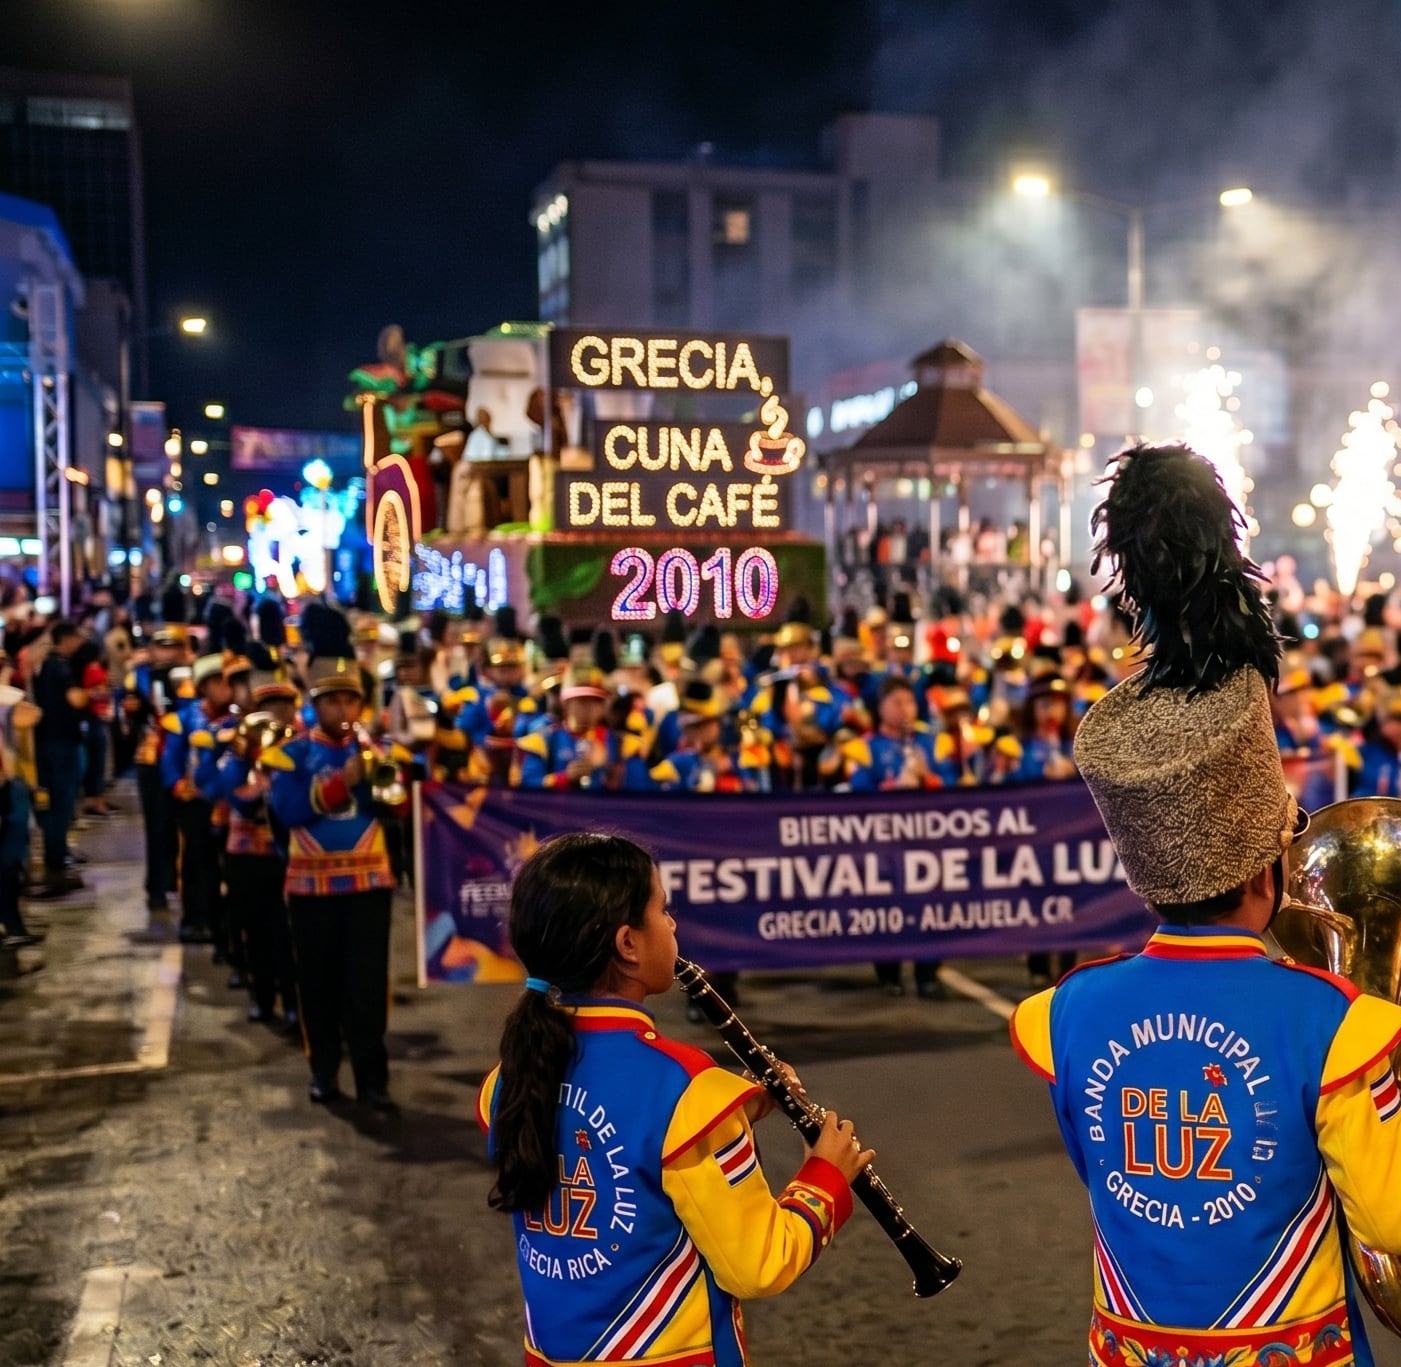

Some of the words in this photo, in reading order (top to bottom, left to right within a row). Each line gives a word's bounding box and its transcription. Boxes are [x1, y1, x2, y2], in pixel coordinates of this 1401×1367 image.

[570, 334, 774, 397] GRECIA,
[604, 423, 734, 472] CUNA
[569, 480, 657, 528] DEL
[665, 473, 781, 528] CAFÉ
[610, 546, 779, 620] 2010
[778, 808, 992, 847] BIENVENIDOS
[996, 806, 1037, 836] AL
[657, 850, 894, 905] FESTIVAL
[903, 848, 970, 895] DE
[981, 844, 1044, 890] LA
[758, 909, 843, 941] GRECIA
[847, 906, 905, 937] 2010
[919, 898, 1040, 933] ALAJUELA,
[1042, 895, 1075, 925] CR
[1083, 1038, 1131, 1142] BANDA
[1130, 1012, 1272, 1096] MUNICIPAL
[588, 1104, 617, 1145] DE
[1120, 1086, 1169, 1120] DE
[1179, 1088, 1229, 1124] LA
[557, 1153, 595, 1187] LA
[605, 1145, 630, 1180] LA
[1123, 1120, 1234, 1181] LUZ
[609, 1186, 638, 1235] LUZ
[1105, 1169, 1185, 1230] GRECIA
[1203, 1182, 1257, 1225] 2010
[566, 1248, 613, 1281] RICA
